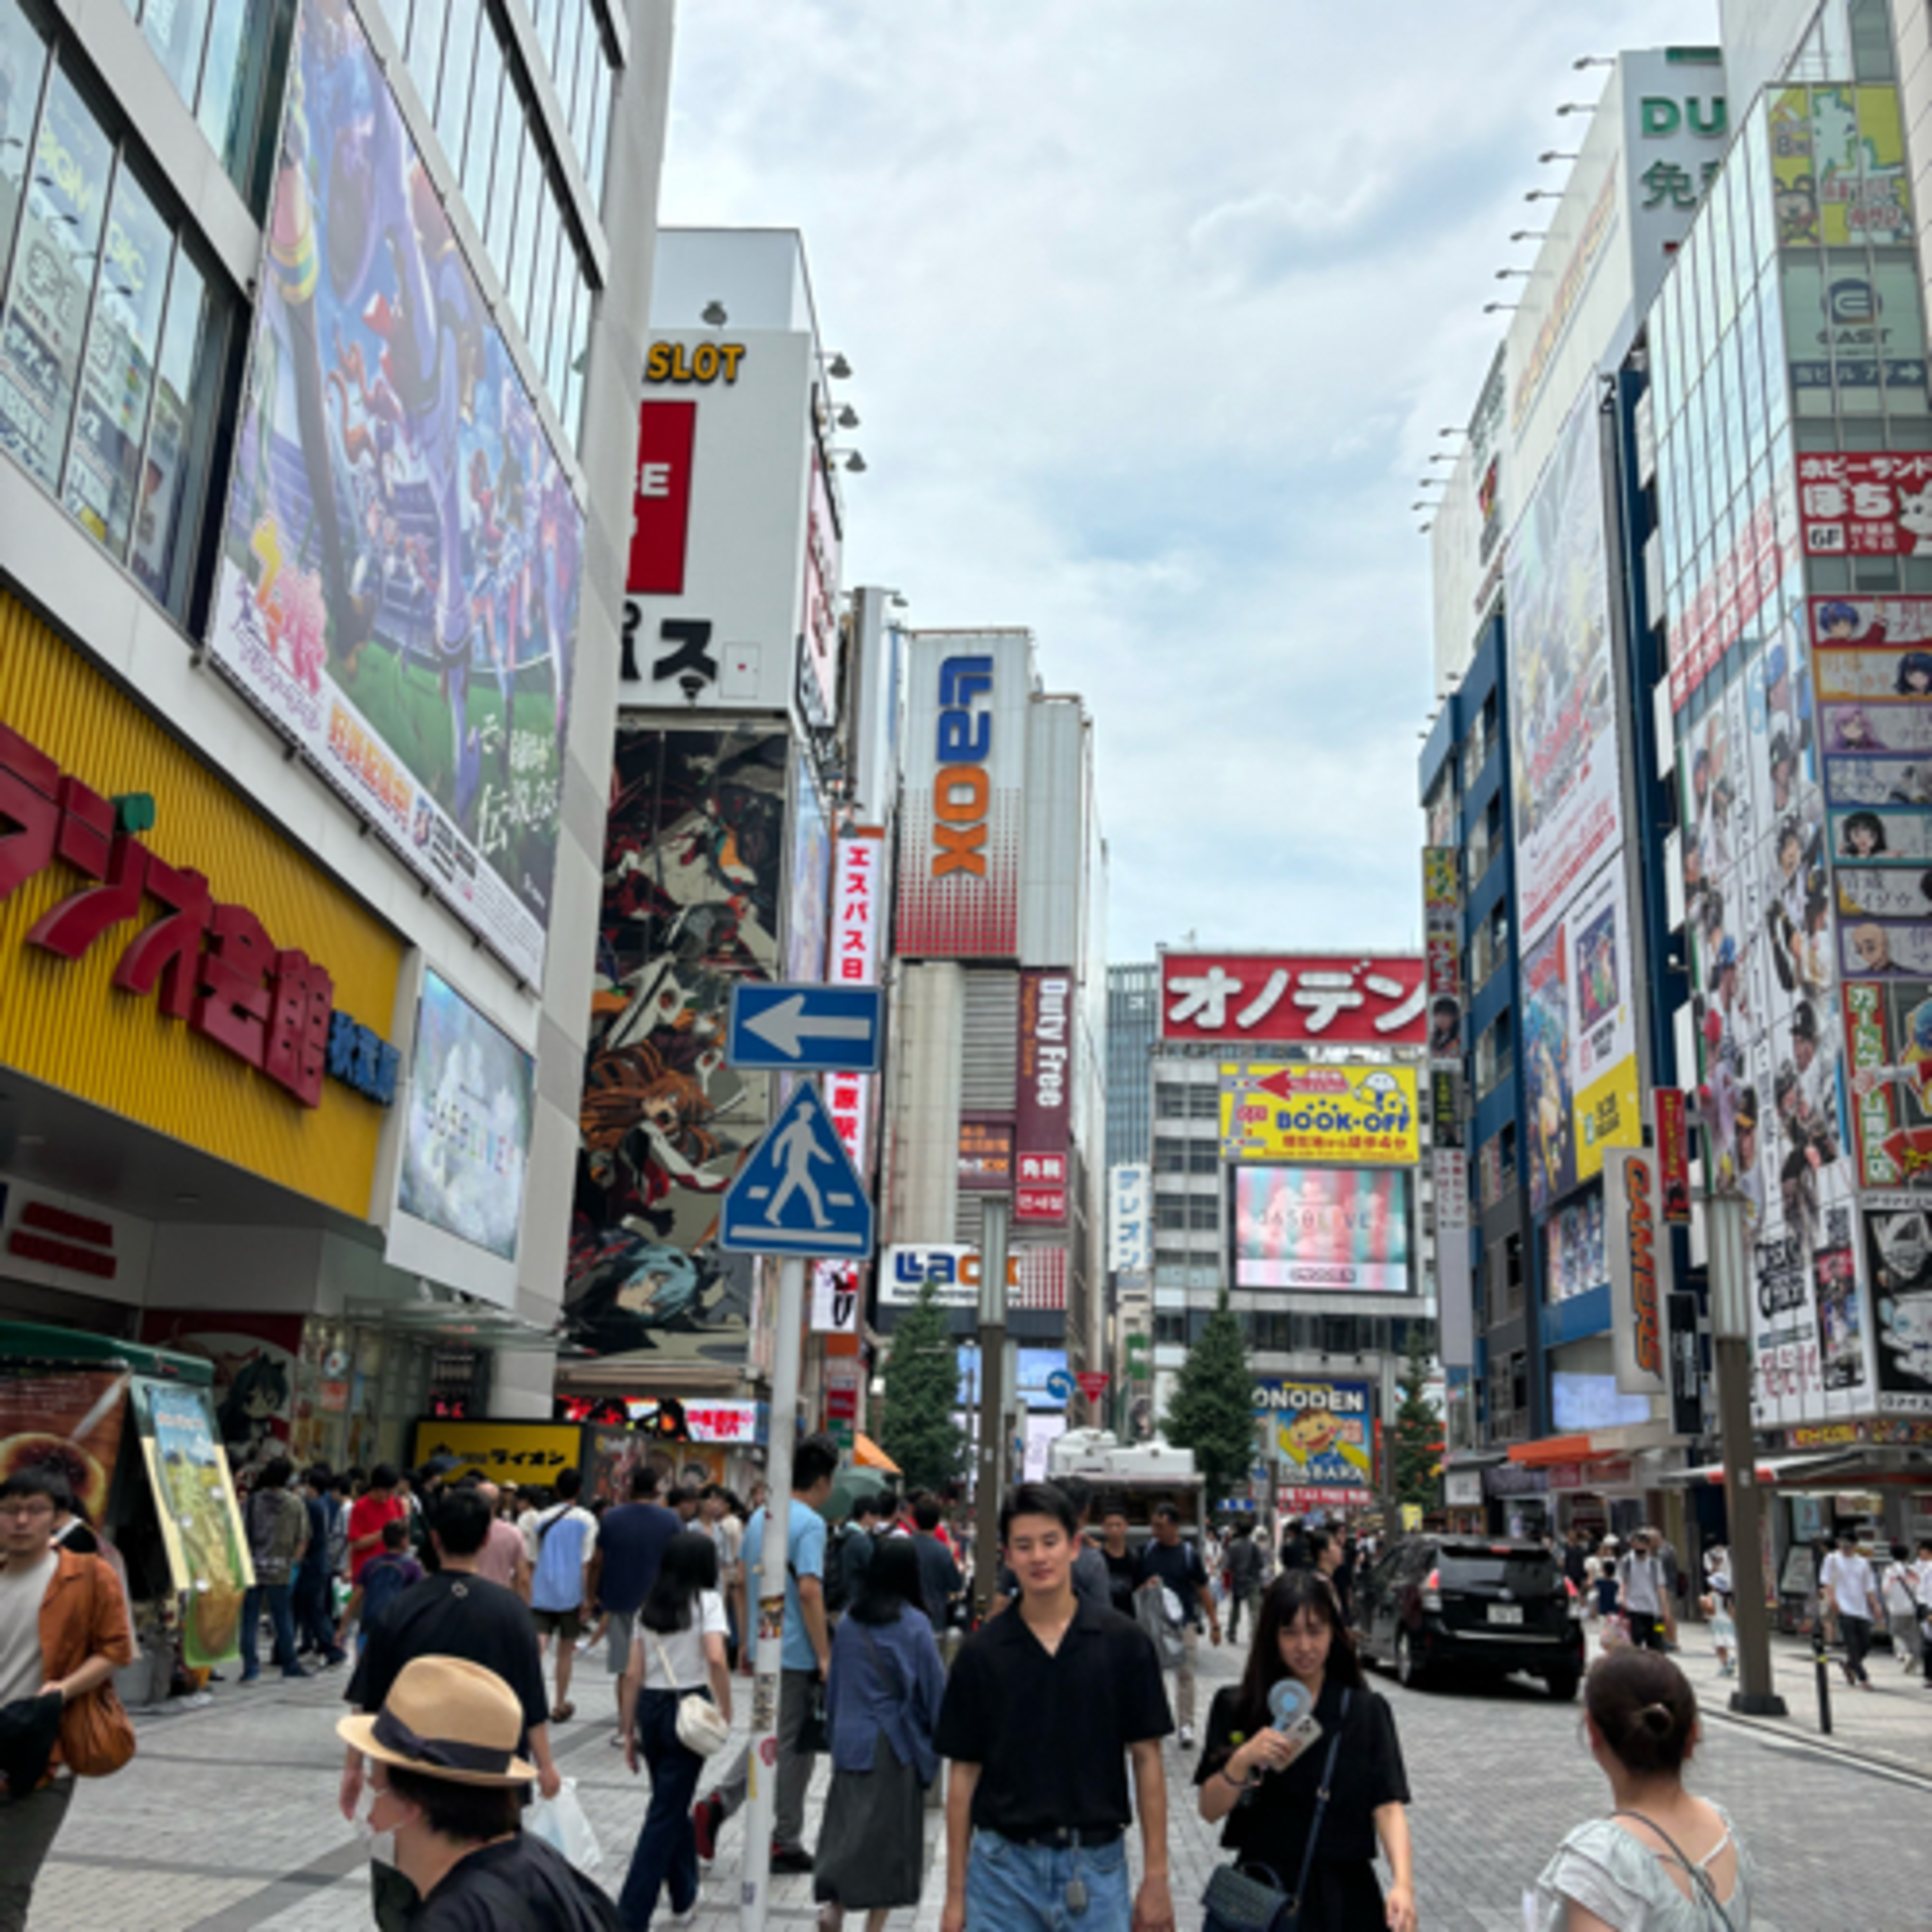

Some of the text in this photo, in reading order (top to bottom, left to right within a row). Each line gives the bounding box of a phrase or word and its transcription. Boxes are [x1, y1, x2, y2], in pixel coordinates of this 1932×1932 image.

[645, 343, 745, 384] SLOT
[1168, 960, 1425, 1032] オノデン
[1036, 1046, 1068, 1106] Free
[1624, 1156, 1663, 1381] GAMERS
[1251, 1386, 1364, 1412] ONODEN
